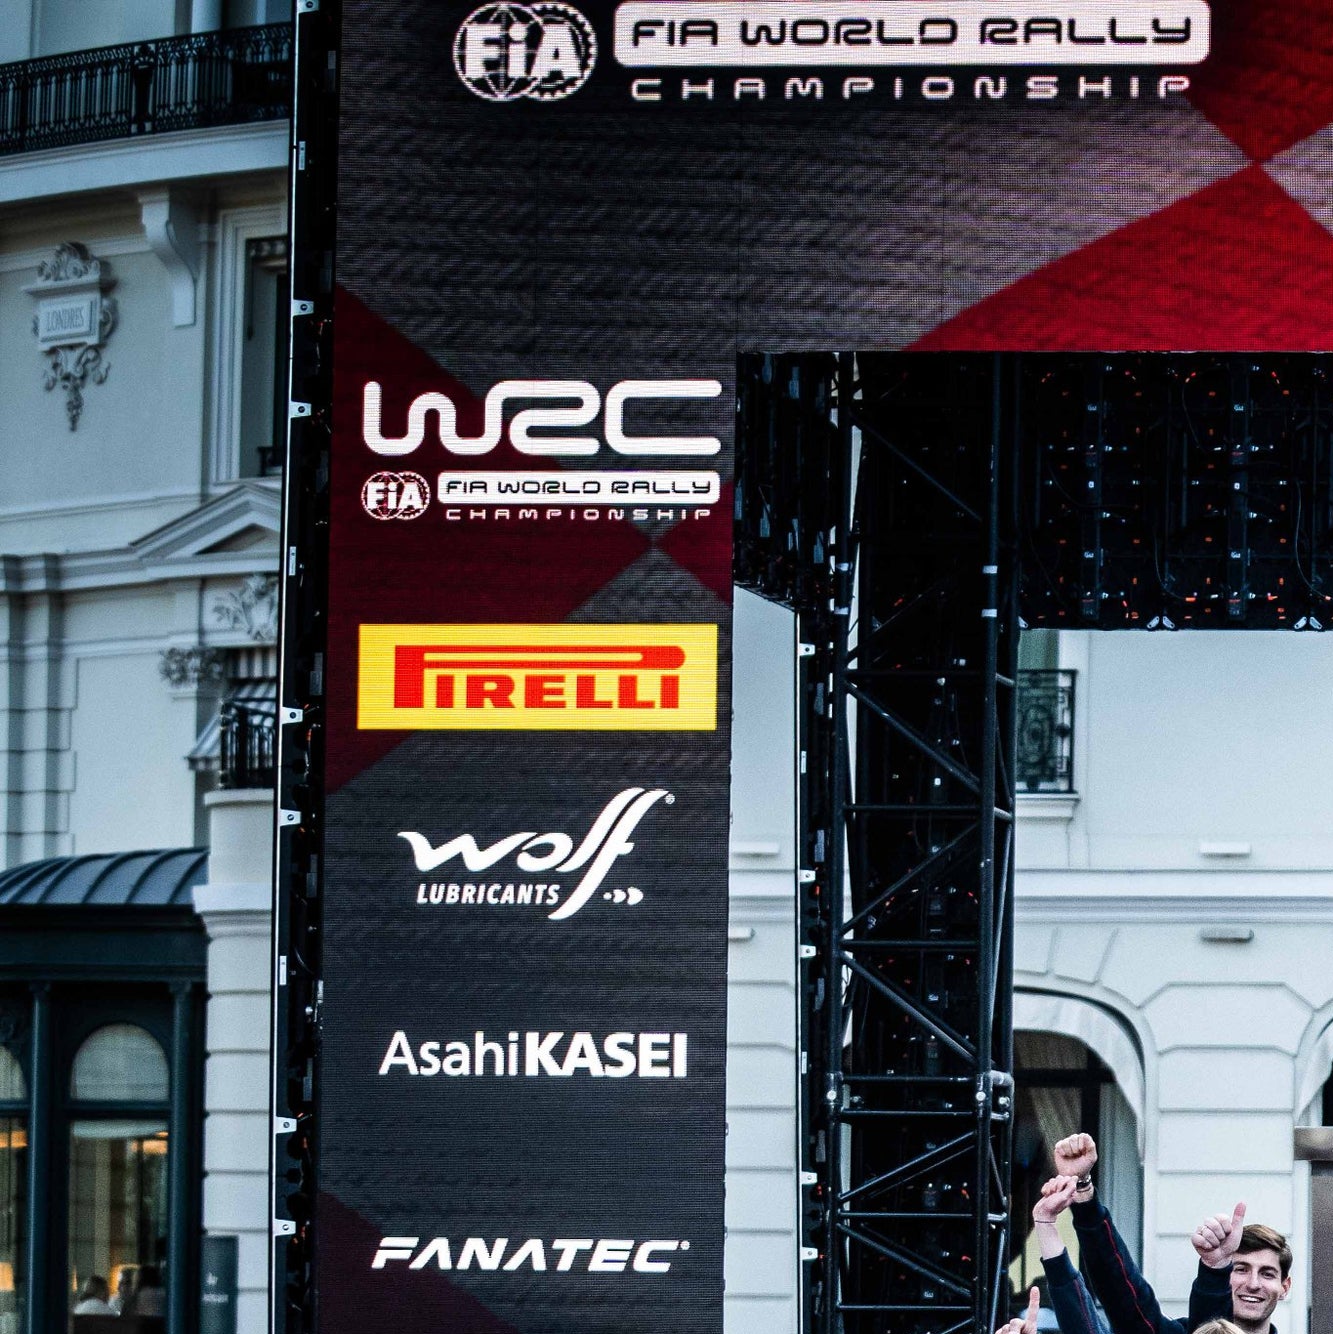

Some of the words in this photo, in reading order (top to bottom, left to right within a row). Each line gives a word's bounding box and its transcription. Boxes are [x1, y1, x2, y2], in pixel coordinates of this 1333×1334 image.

[632, 16, 718, 46] FIA
[741, 16, 958, 46] WORLD
[980, 16, 1192, 45] RALLY
[631, 75, 1192, 102] CHAMPIONSHIP
[363, 380, 722, 456] WRC
[446, 480, 488, 495] FIA
[498, 480, 601, 495] WORLD
[611, 480, 711, 495] RALLY
[445, 509, 711, 521] CHAMPIONSHIP
[394, 645, 686, 709] PIRELLI
[416, 883, 561, 906] LUBRICANTS
[371, 1237, 679, 1272] FANATEC
